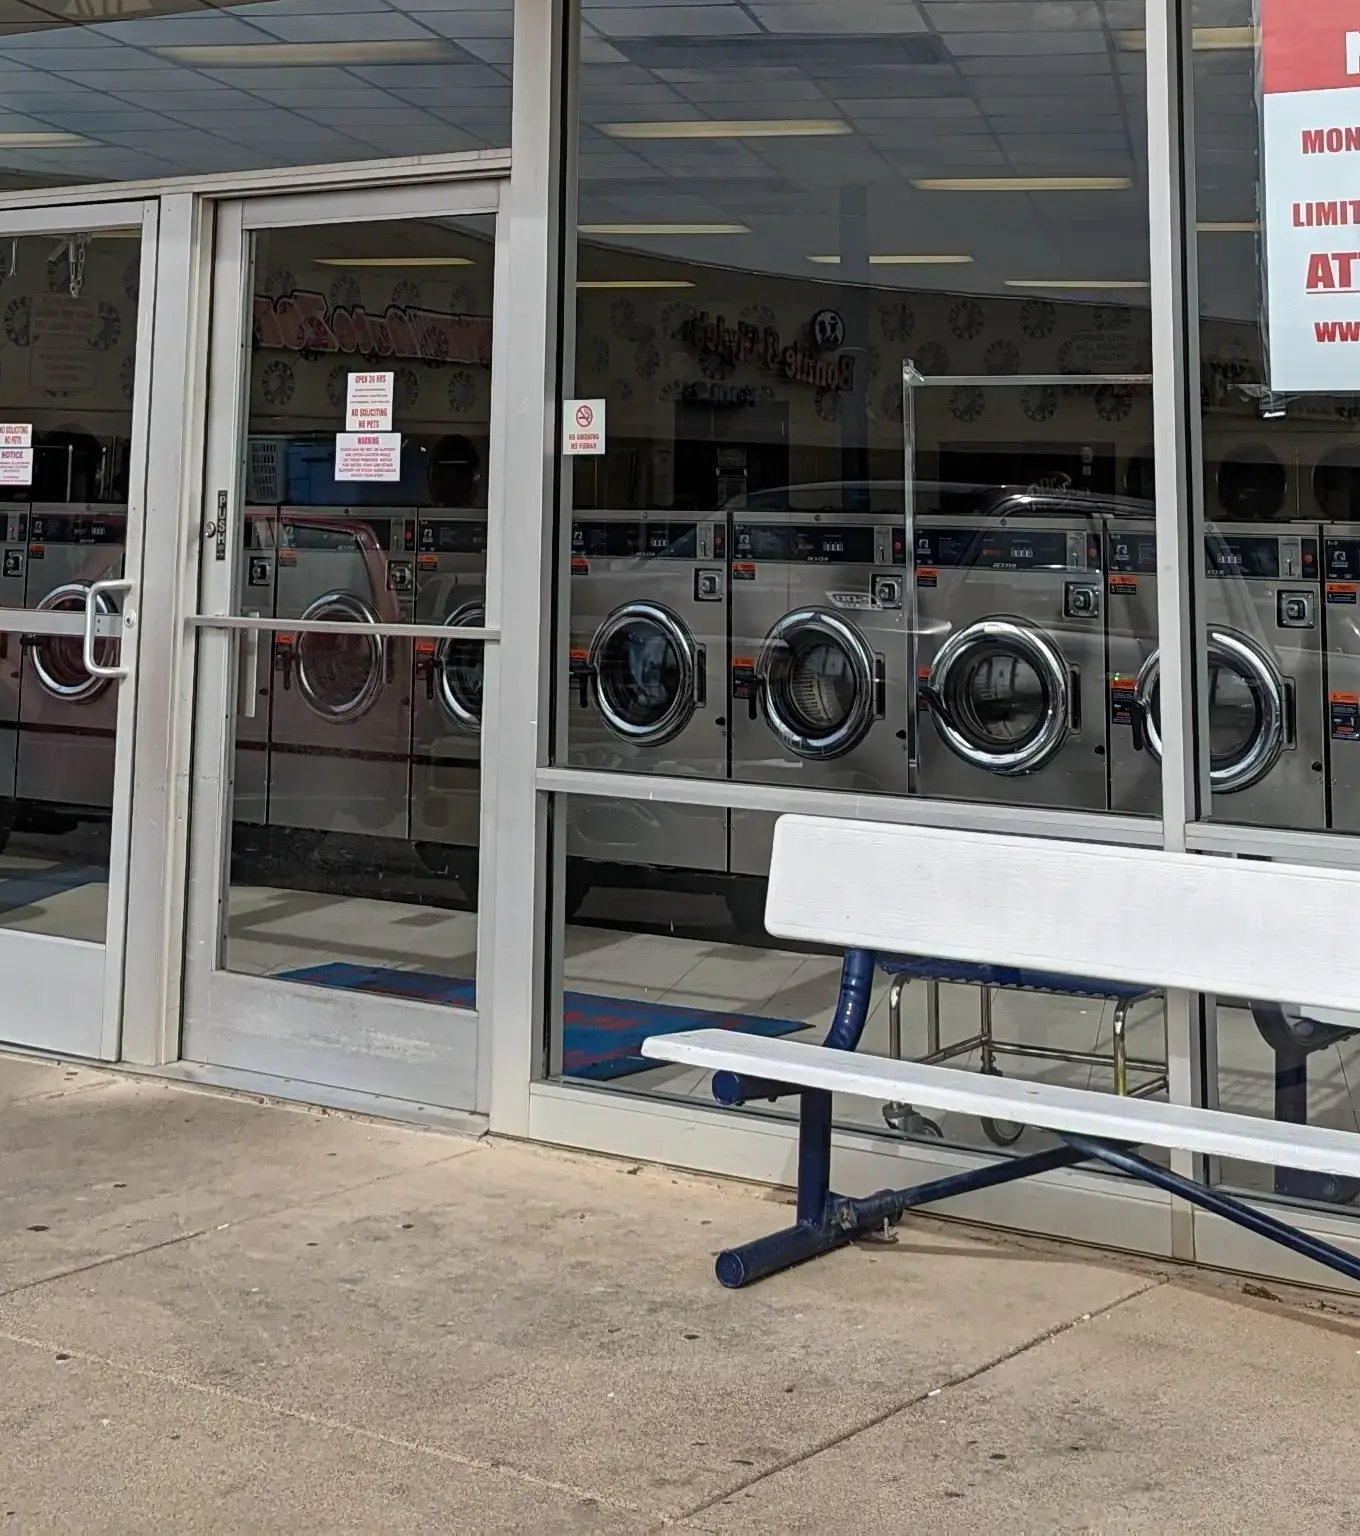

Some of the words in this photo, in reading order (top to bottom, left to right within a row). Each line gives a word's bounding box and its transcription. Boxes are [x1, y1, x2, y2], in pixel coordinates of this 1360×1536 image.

[351, 408, 358, 417] NO
[359, 408, 387, 417] SOLICITING
[366, 420, 379, 428] PETS
[218, 495, 226, 545] PUSH
